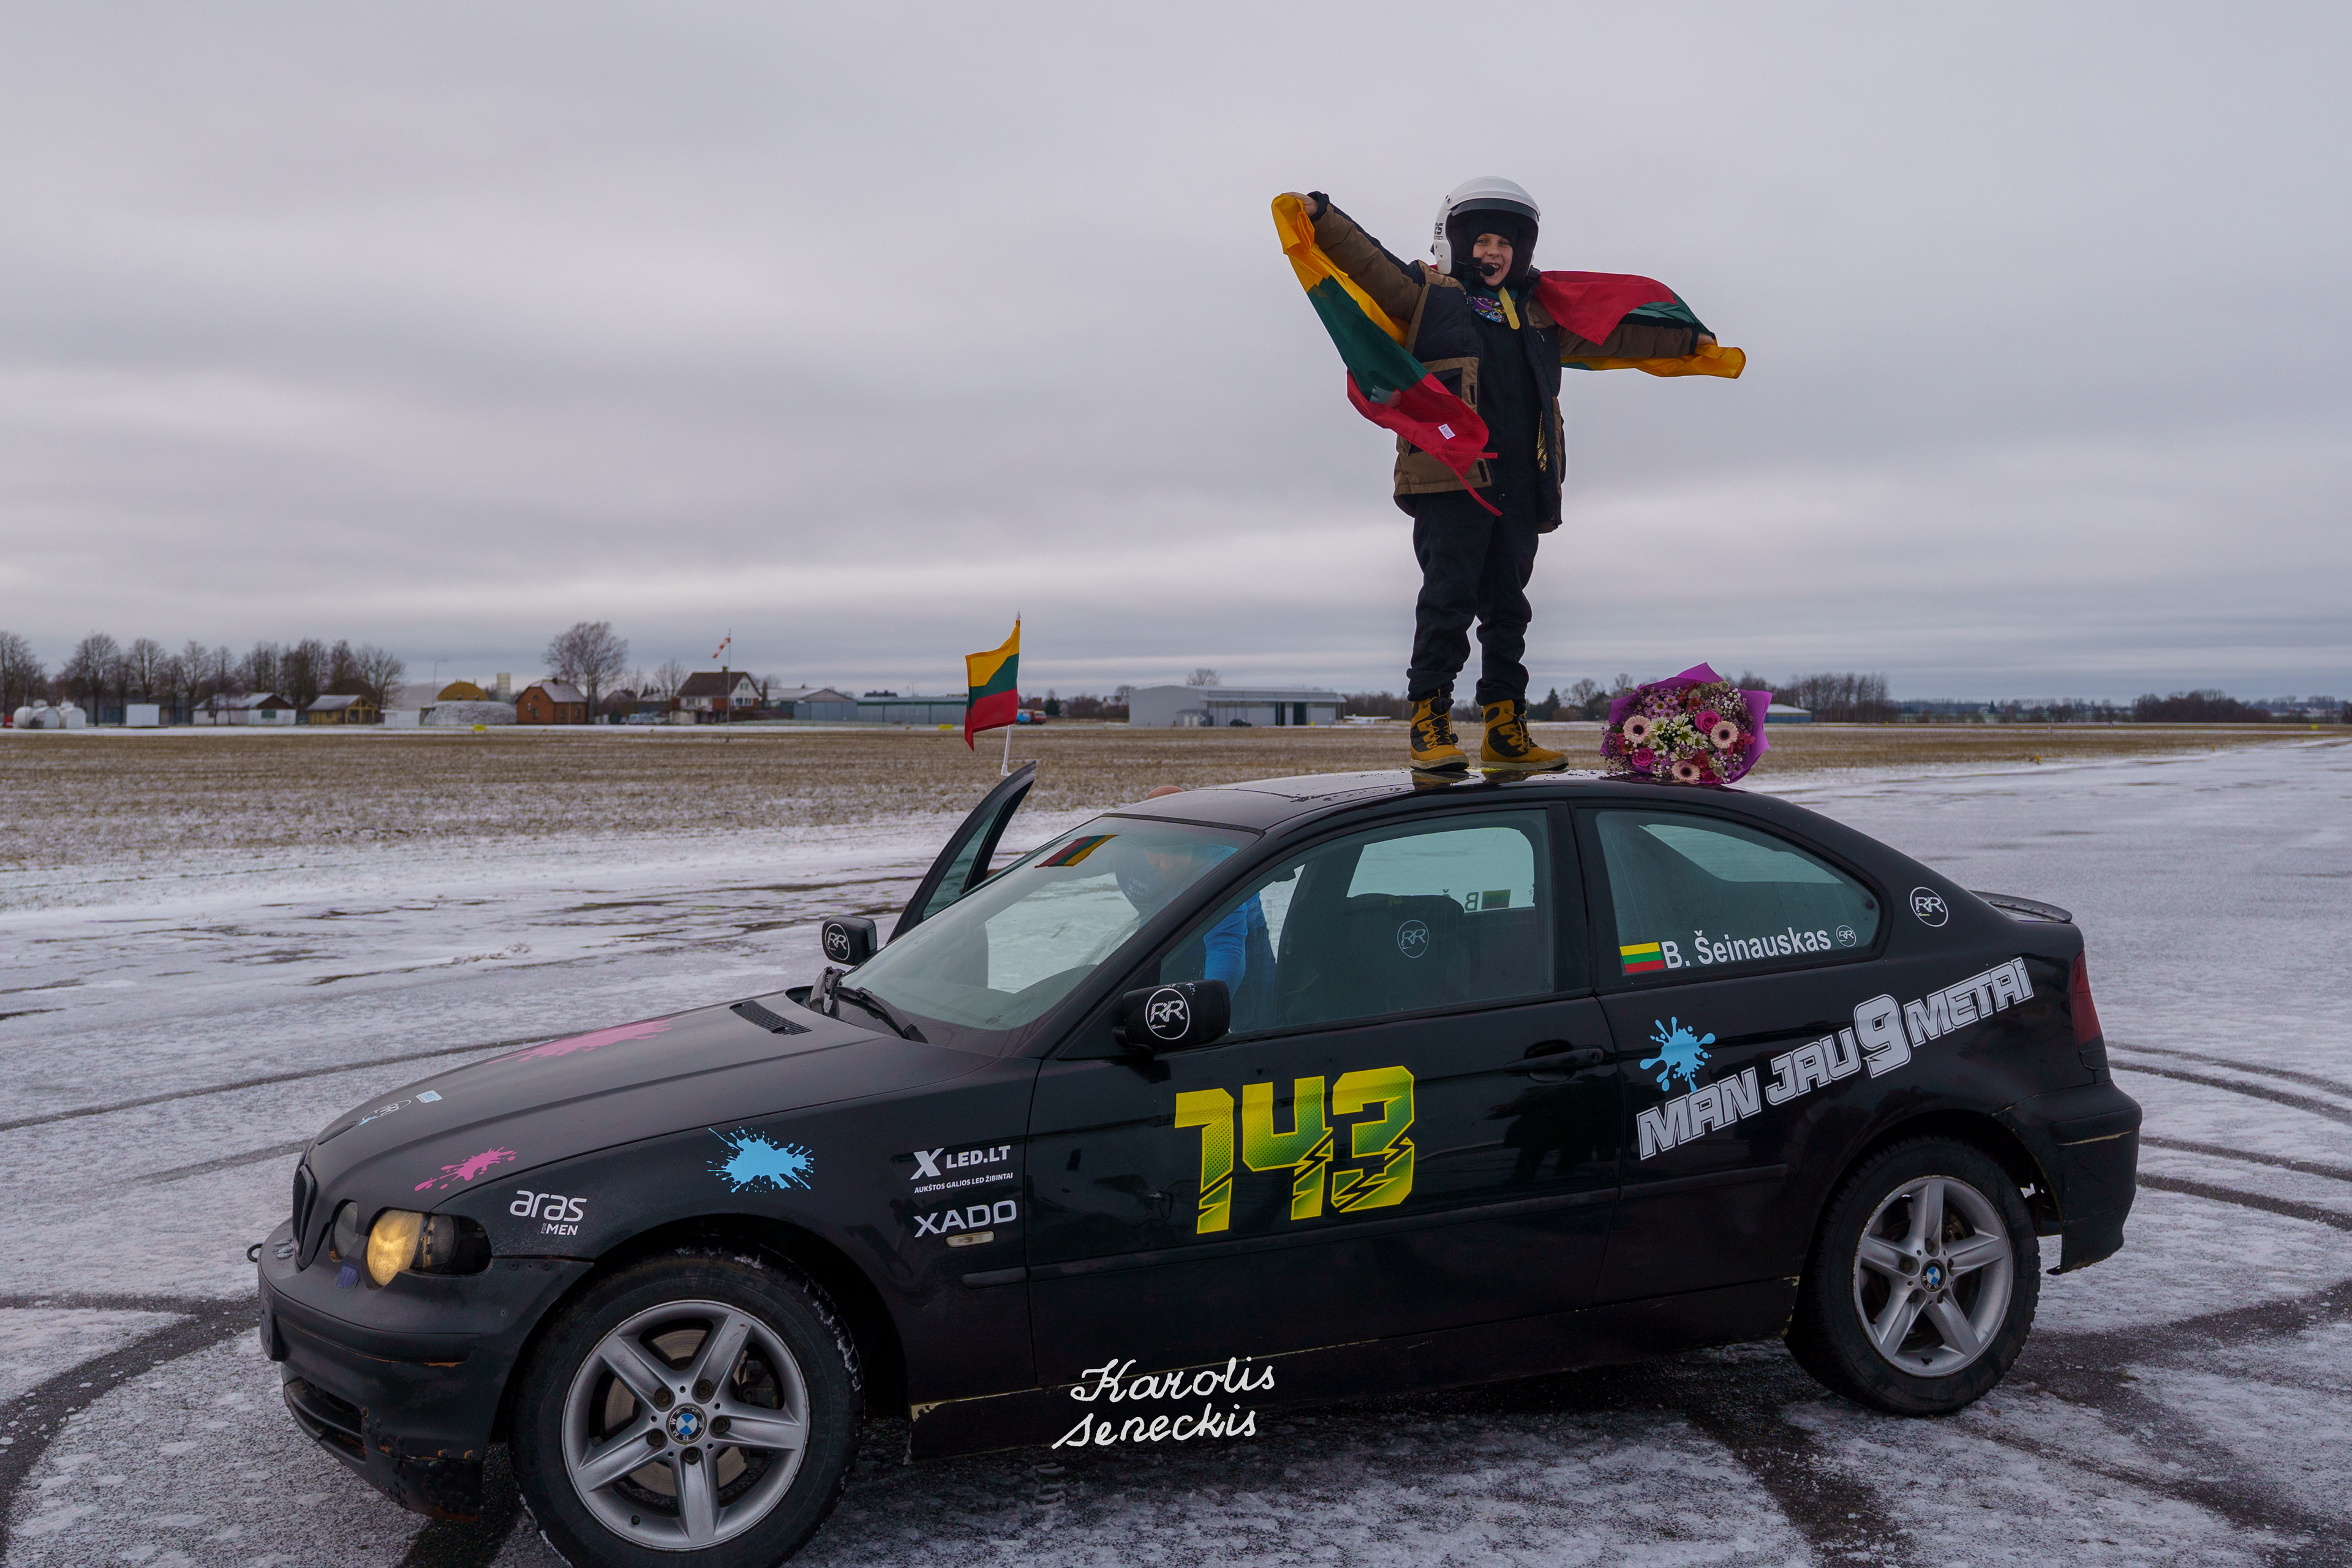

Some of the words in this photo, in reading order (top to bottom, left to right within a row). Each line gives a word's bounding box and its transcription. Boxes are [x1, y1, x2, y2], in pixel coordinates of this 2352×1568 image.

[1661, 941, 1691, 969] B.
[1694, 927, 1832, 965] Šeinauskas
[1636, 1066, 1762, 1161] MAN
[1766, 1027, 1861, 1106] JAU
[1853, 994, 1911, 1078] 9
[1903, 957, 2034, 1047] METAI
[914, 1183, 946, 1194] AUKŠTOS
[946, 1178, 971, 1188] GALIOS
[971, 1177, 985, 1185] LED
[985, 1172, 1014, 1183] ŽIBINTAI
[510, 1190, 587, 1222] aras
[913, 1200, 1017, 1238] XADO
[546, 1223, 579, 1235] MEN
